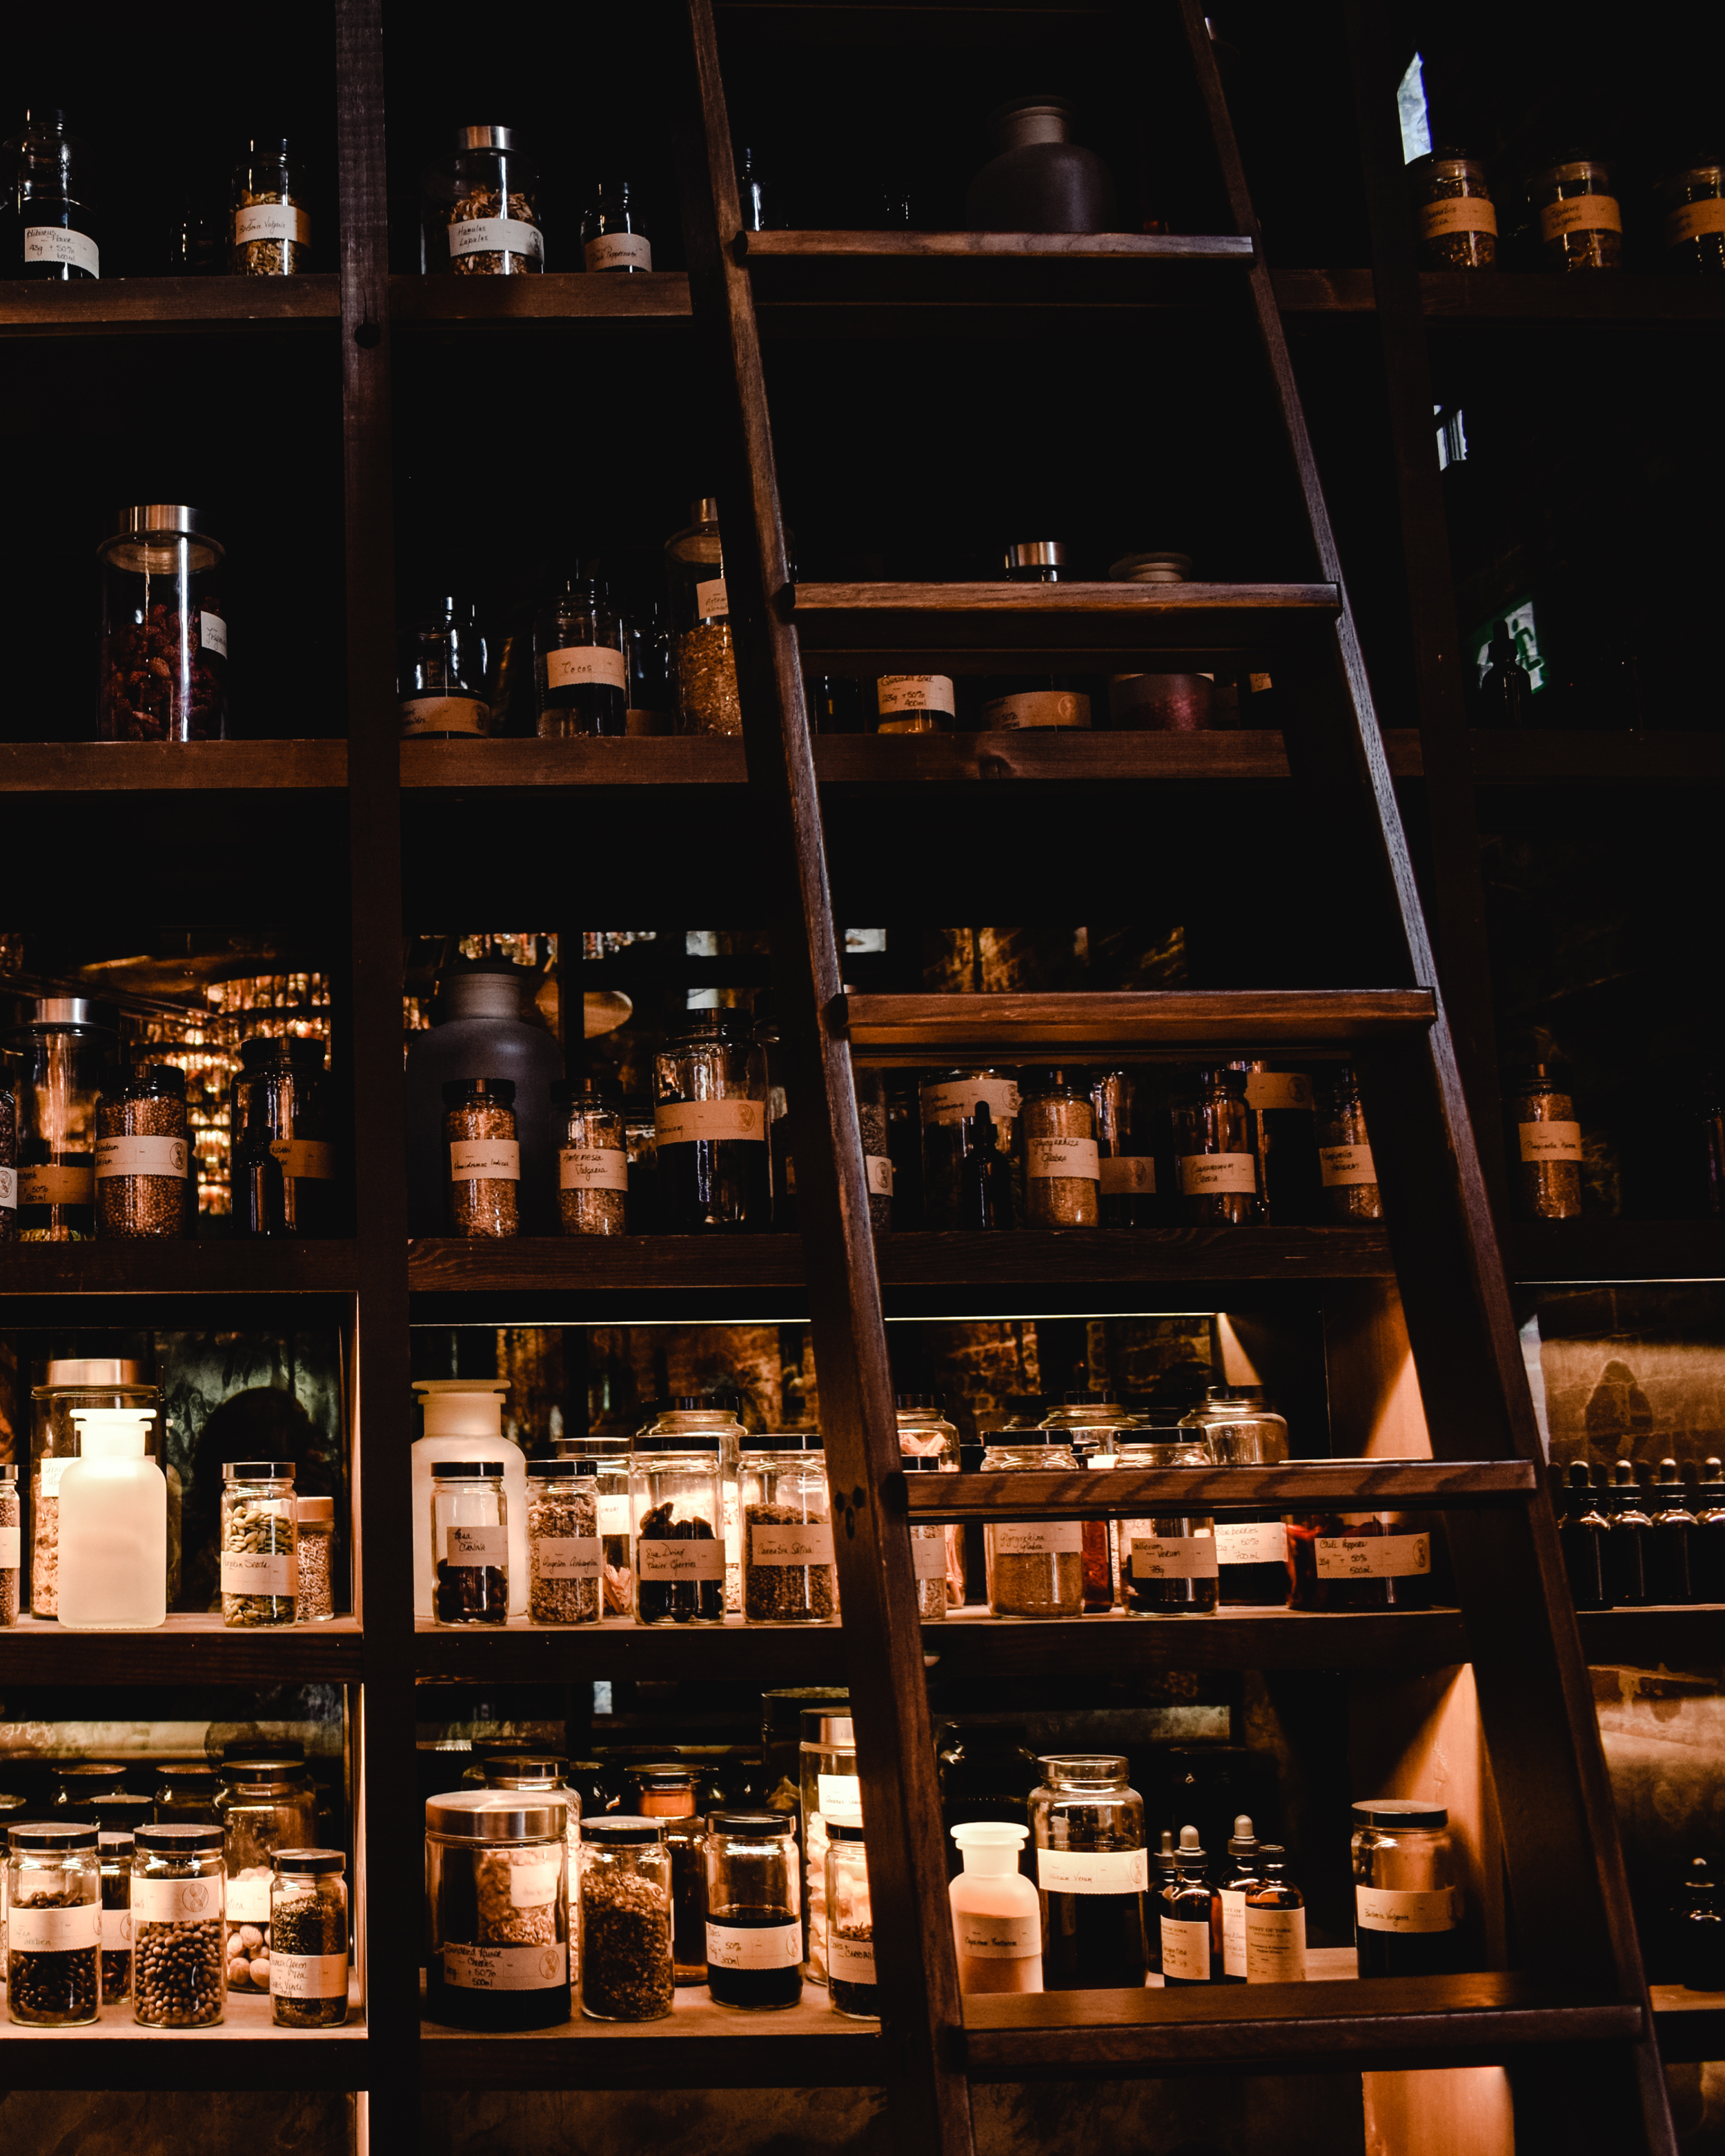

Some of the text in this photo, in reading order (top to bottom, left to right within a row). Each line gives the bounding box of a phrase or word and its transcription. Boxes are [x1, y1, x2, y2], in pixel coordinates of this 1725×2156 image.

[27, 230, 56, 239] Hibiscus
[57, 245, 75, 253] 50%
[562, 661, 592, 674] Cocos
